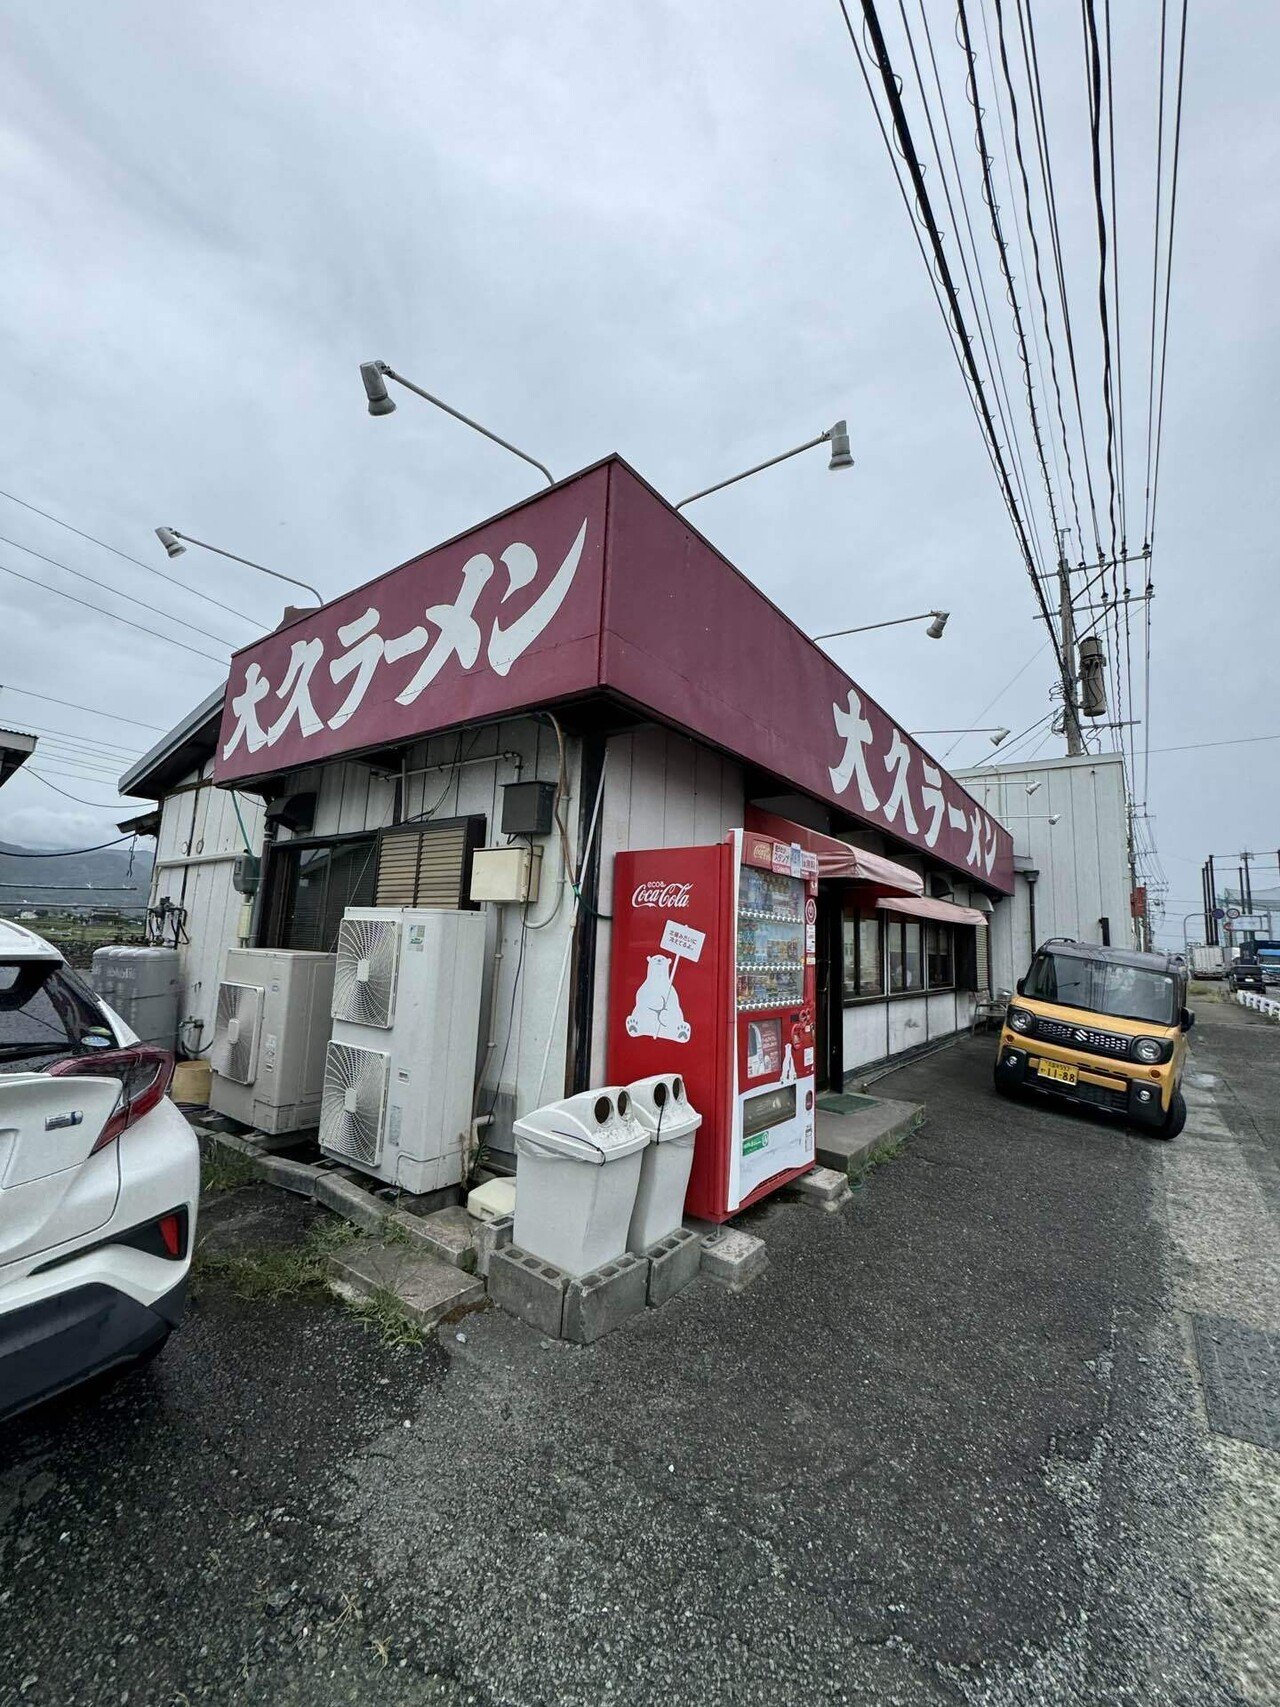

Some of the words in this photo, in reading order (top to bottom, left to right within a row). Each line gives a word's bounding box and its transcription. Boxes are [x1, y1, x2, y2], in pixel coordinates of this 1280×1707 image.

[223, 517, 588, 761] 大久ラーメン
[828, 688, 997, 876] 大久ラーメン
[631, 883, 693, 908] Coca-Cola
